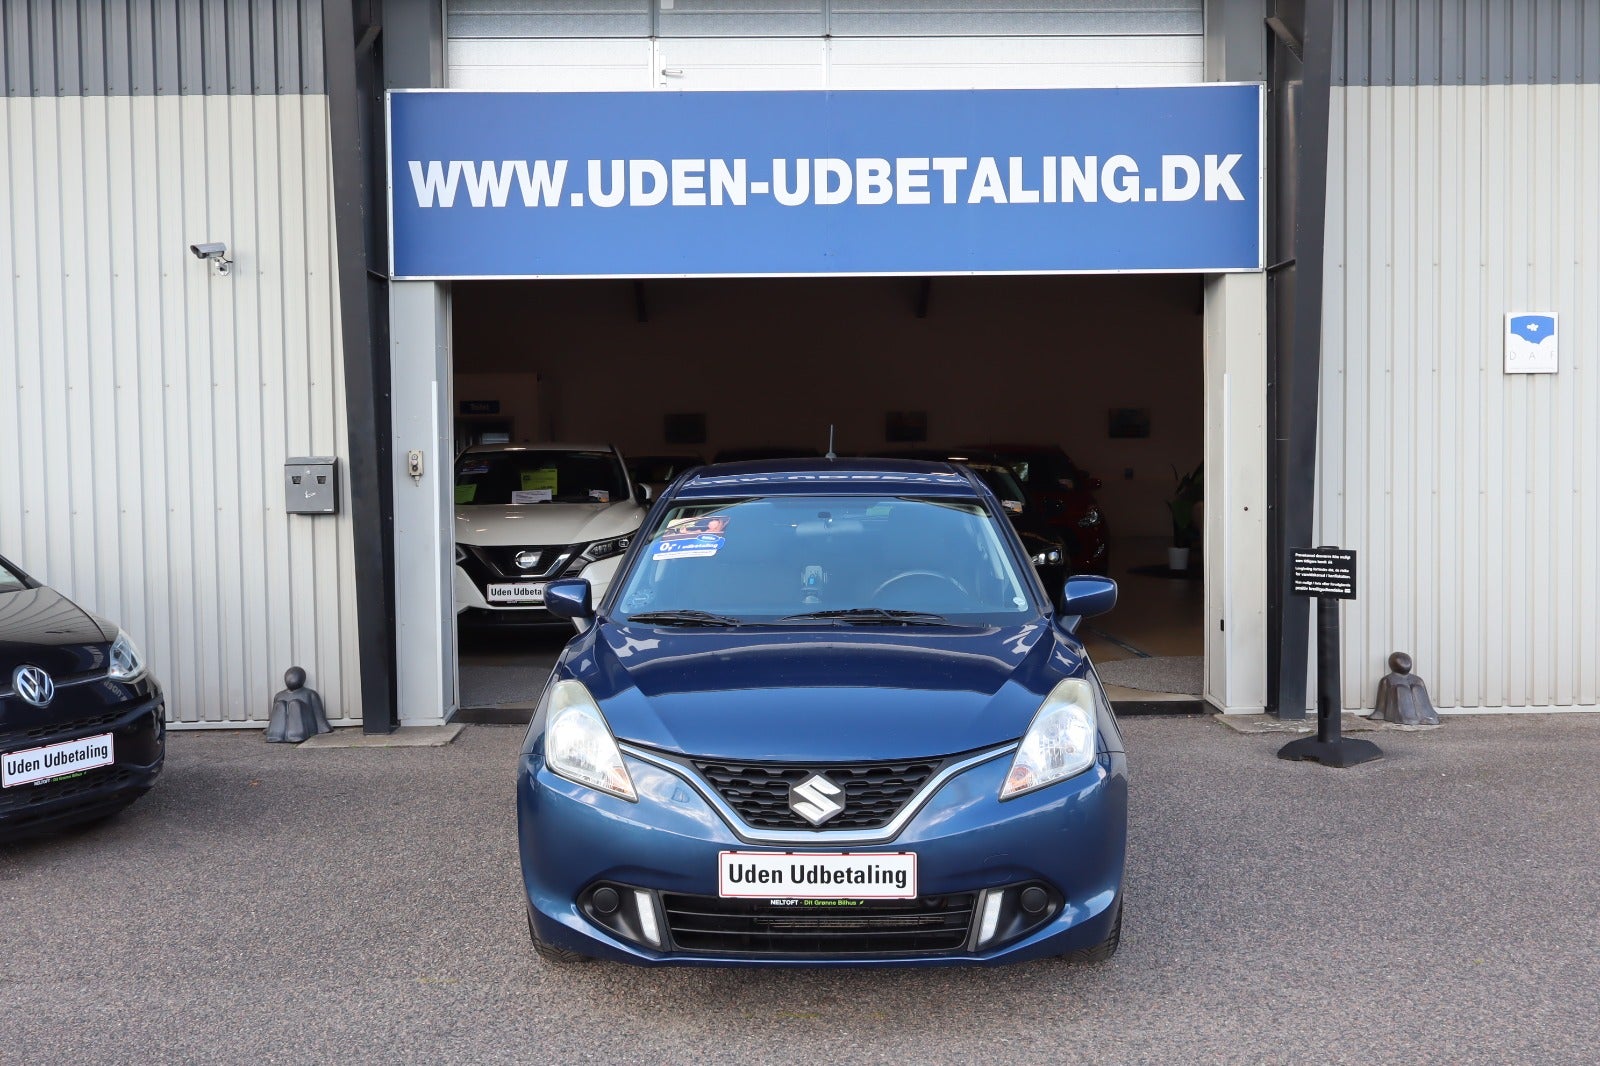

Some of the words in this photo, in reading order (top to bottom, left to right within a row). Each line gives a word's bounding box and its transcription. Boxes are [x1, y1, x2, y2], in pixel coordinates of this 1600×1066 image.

[408, 154, 1245, 207] WWW.UDEN-UDBETALING.DK
[491, 588, 511, 596] Uden
[513, 587, 542, 596] Udbeta
[8, 759, 40, 776] Uden
[44, 745, 108, 768] Udbetaling
[728, 863, 783, 884] Uden
[790, 864, 907, 889] Udbetaling
